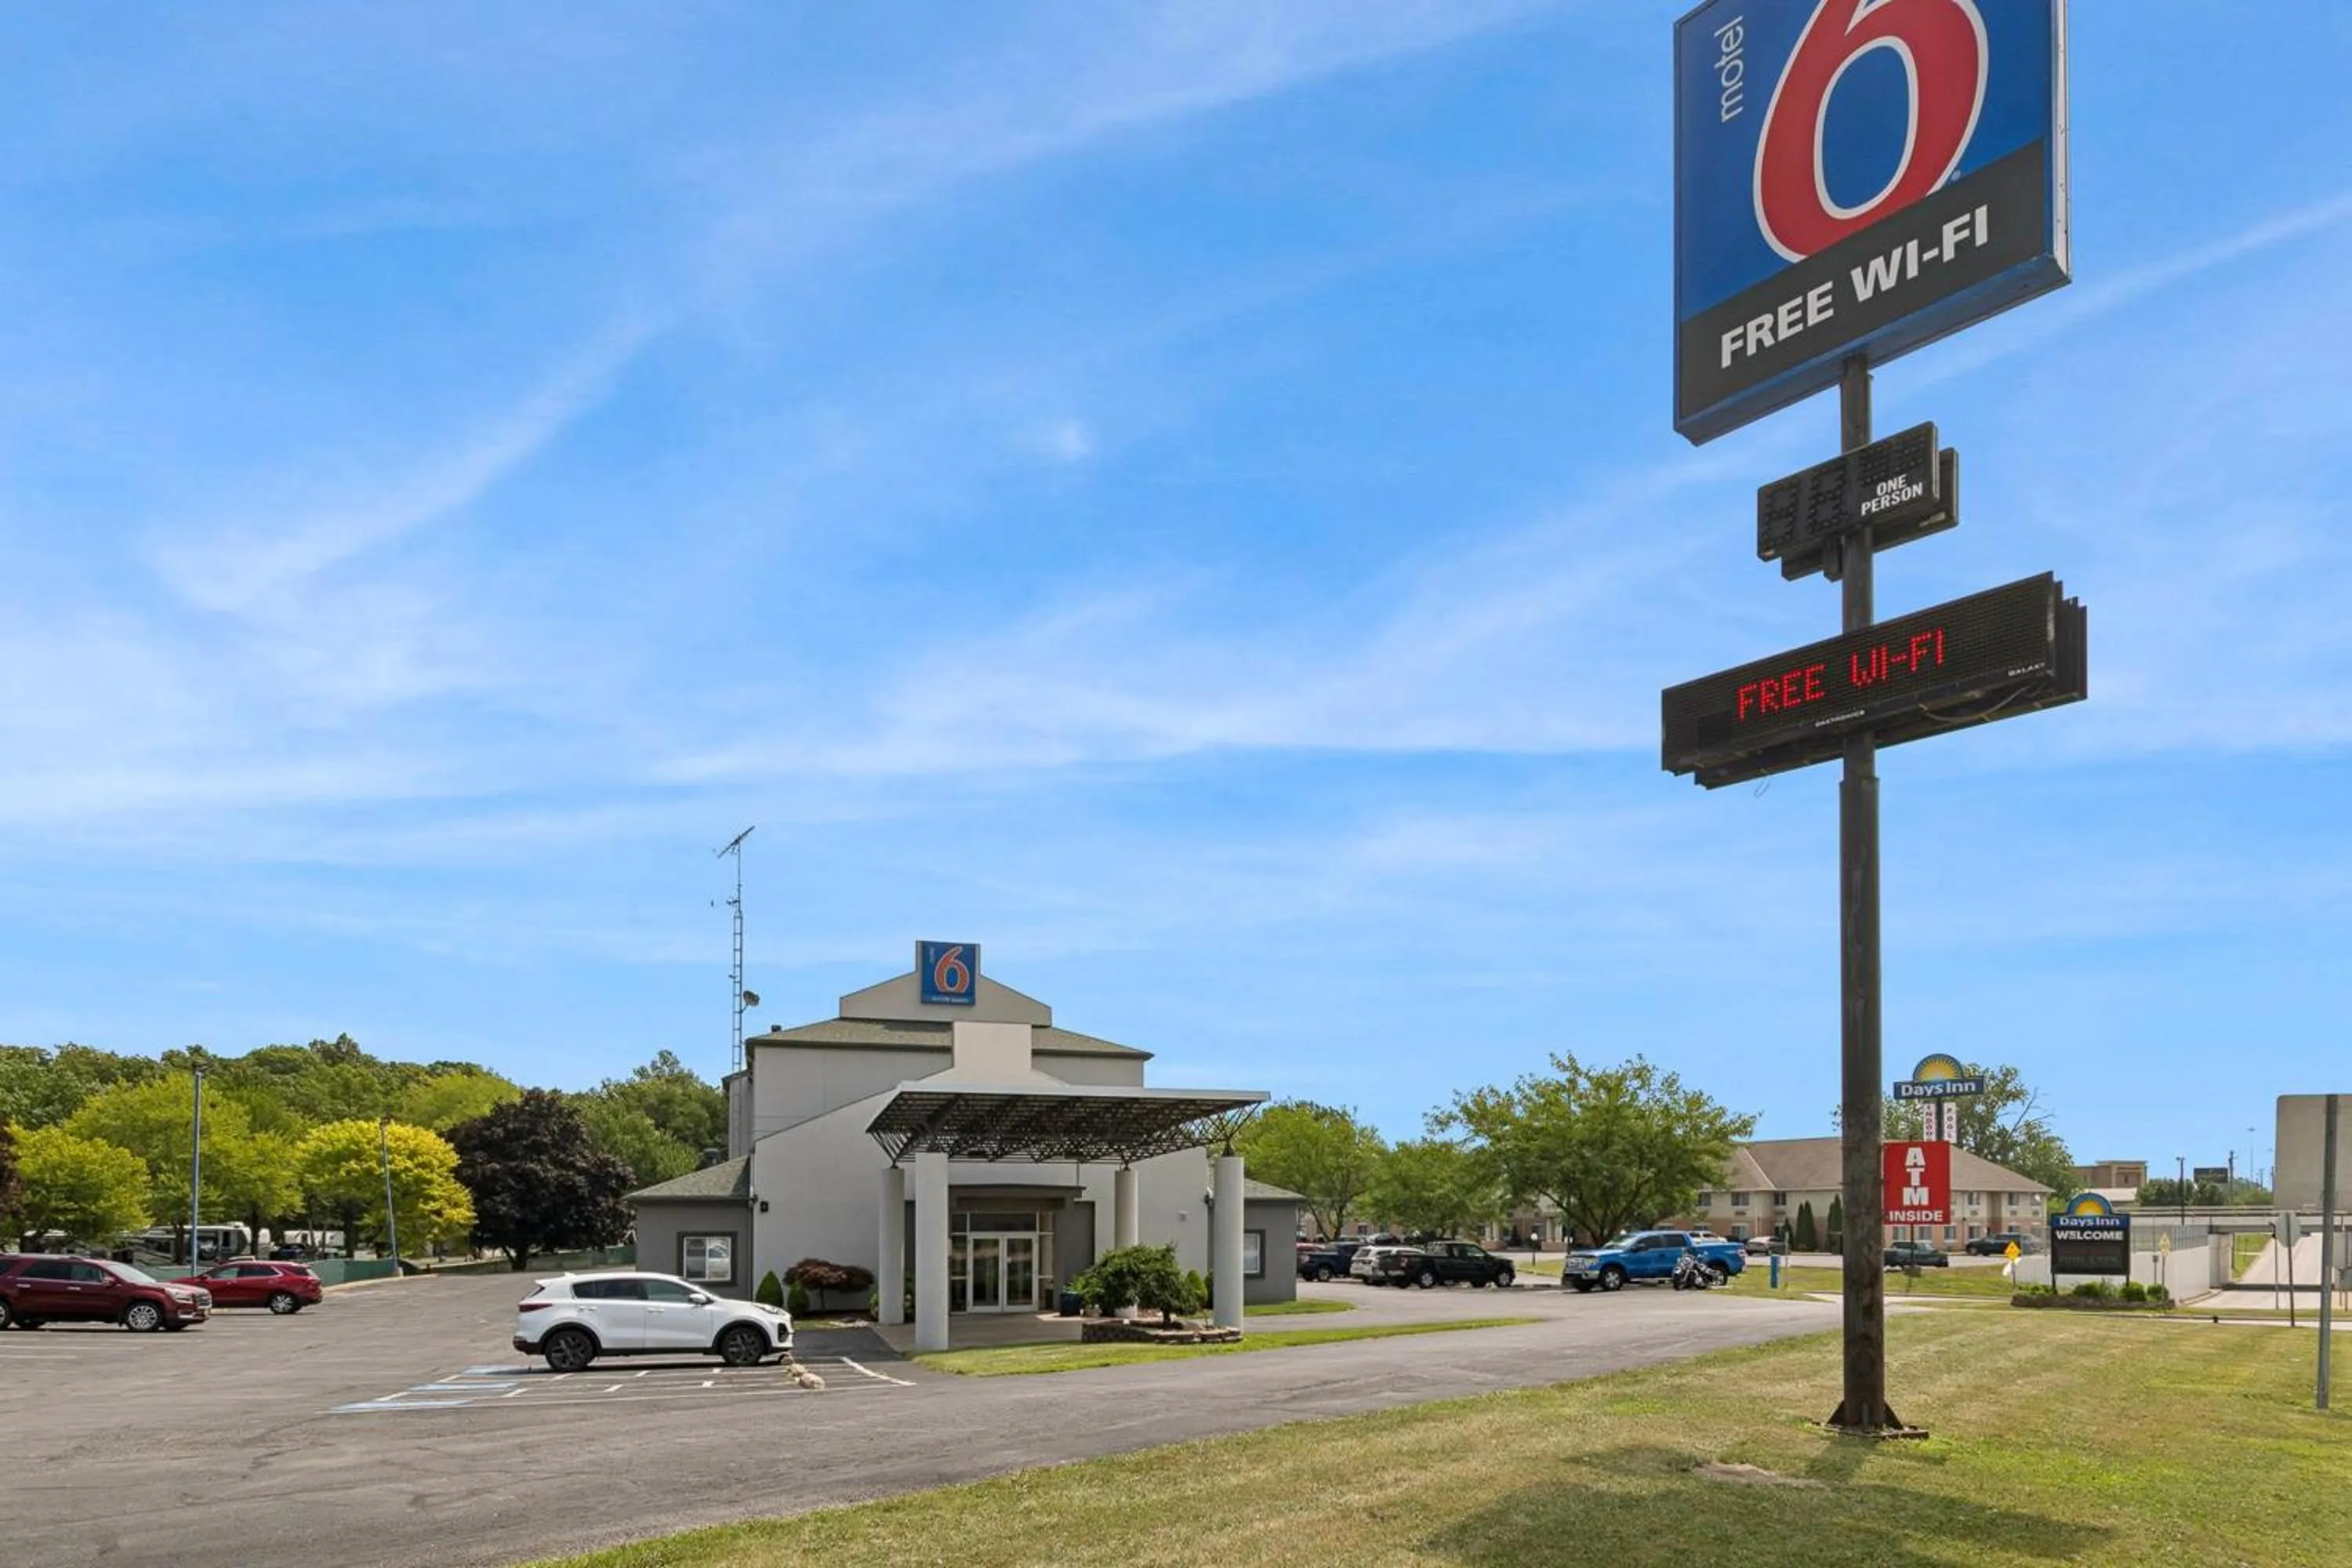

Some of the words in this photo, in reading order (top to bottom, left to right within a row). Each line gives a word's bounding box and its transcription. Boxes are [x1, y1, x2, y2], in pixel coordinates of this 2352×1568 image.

[1714, 15, 1744, 123] motel
[1753, 0, 1989, 264] 6
[1721, 281, 1835, 368] FREE
[1850, 205, 1989, 303] WI-FI
[1860, 481, 1923, 516] PERSON
[1876, 474, 1907, 496] ONE
[1736, 662, 1827, 722] FREE
[1849, 626, 1945, 688] WI-FI
[934, 946, 970, 993] 6
[1900, 1083, 1944, 1097] Days
[1946, 1081, 1976, 1094] Inn
[1902, 1147, 1929, 1207] ATM
[1888, 1210, 1944, 1222] INSIDE
[2060, 1216, 2094, 1227] Days
[2096, 1216, 2121, 1226] Inn
[2056, 1229, 2124, 1241] WELCOME
